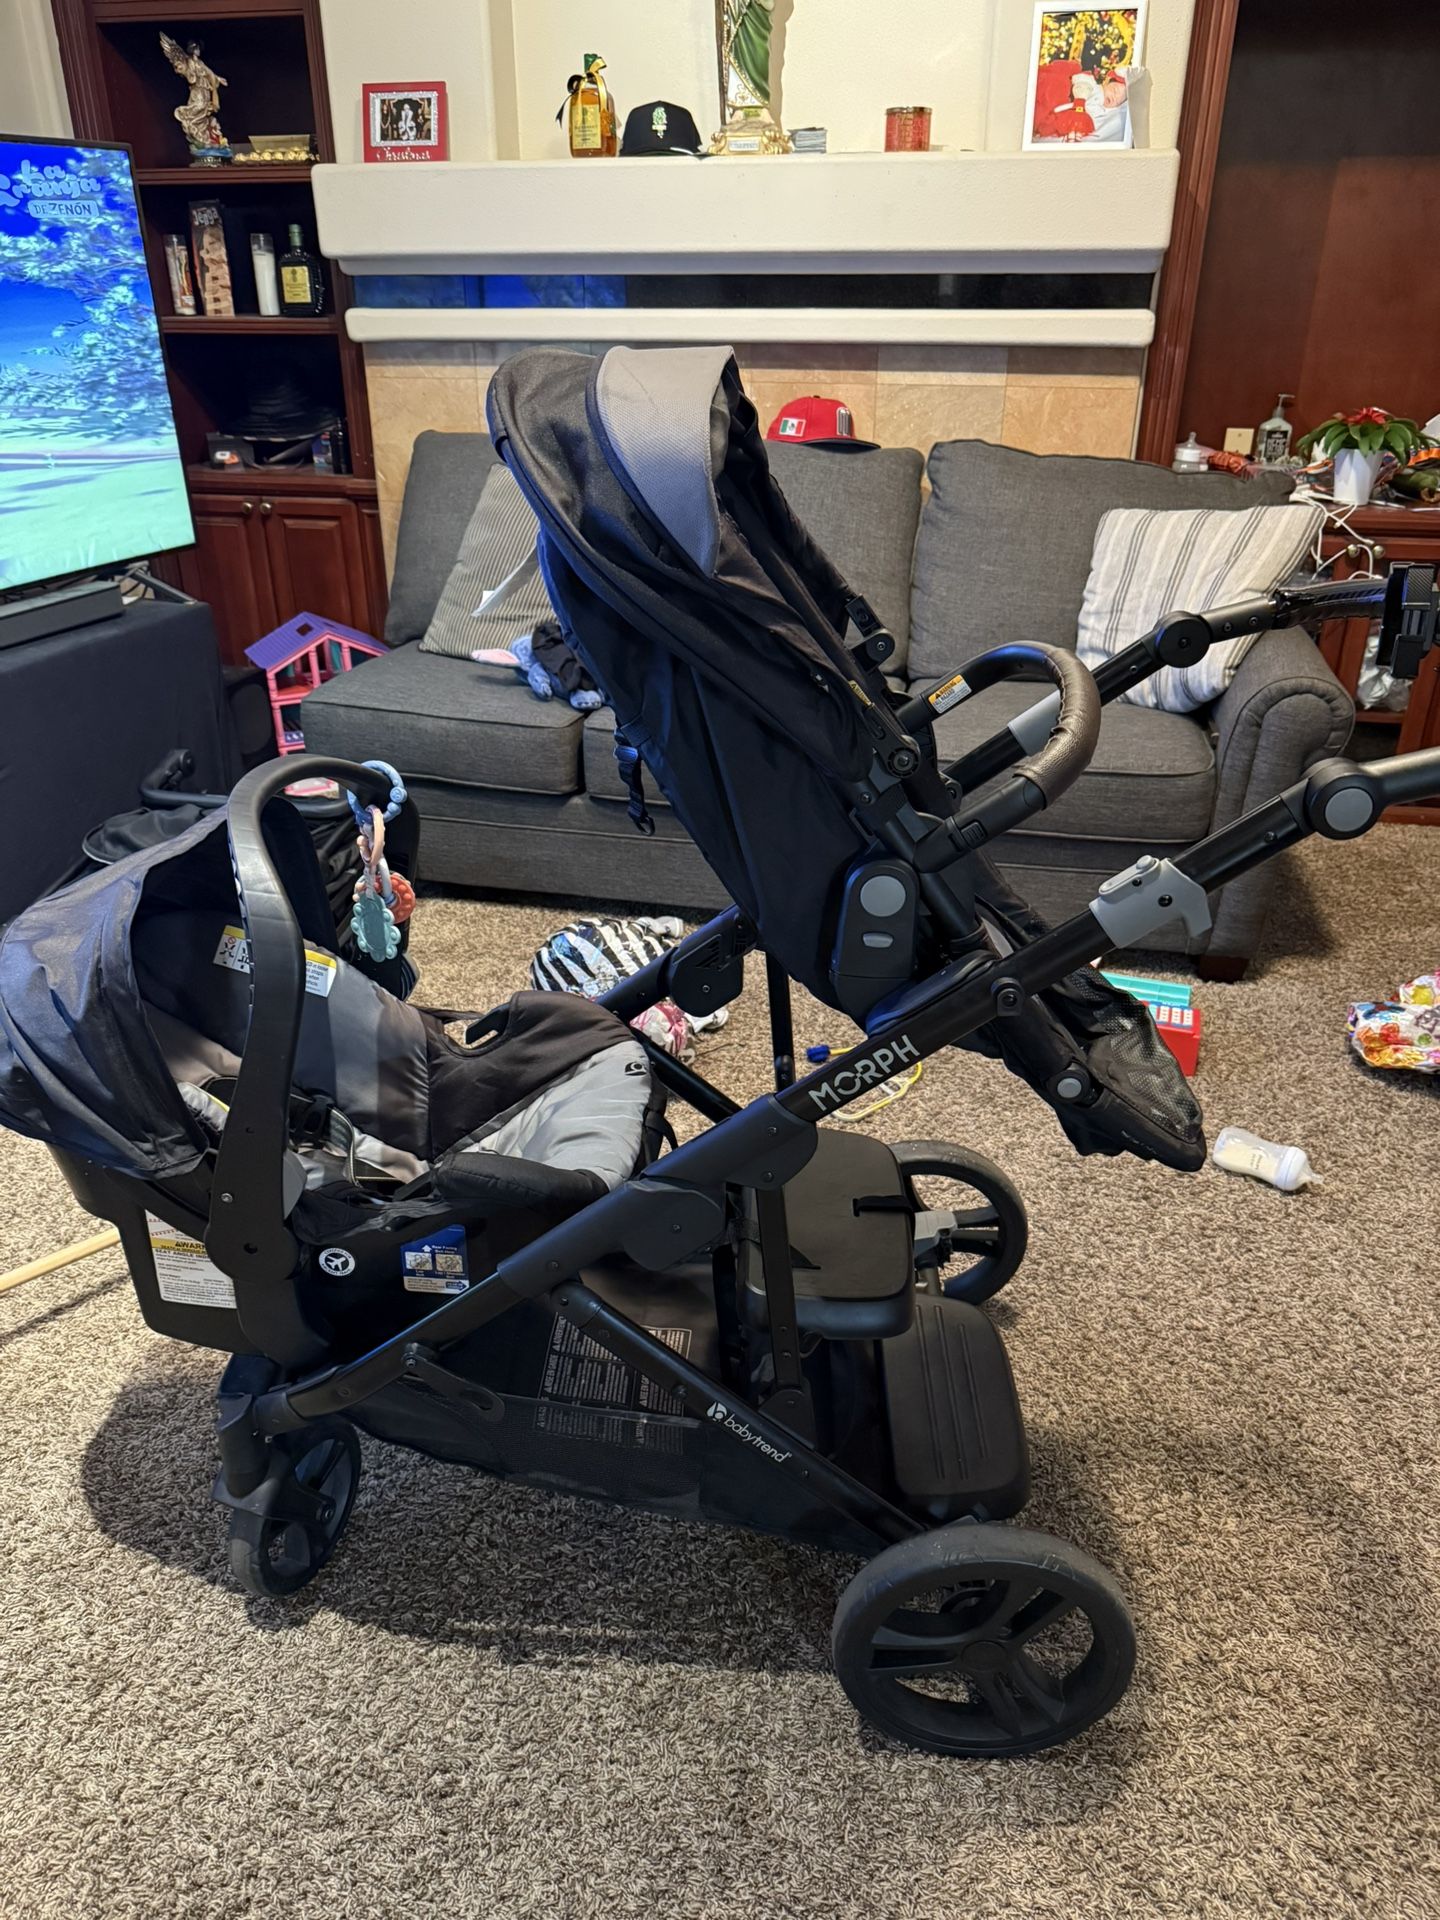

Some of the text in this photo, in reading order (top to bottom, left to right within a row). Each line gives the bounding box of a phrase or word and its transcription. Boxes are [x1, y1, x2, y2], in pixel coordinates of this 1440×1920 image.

[33, 202, 92, 216] DE ZENÓN
[808, 1034, 921, 1112] MORPH
[723, 1413, 791, 1463] babytrend
